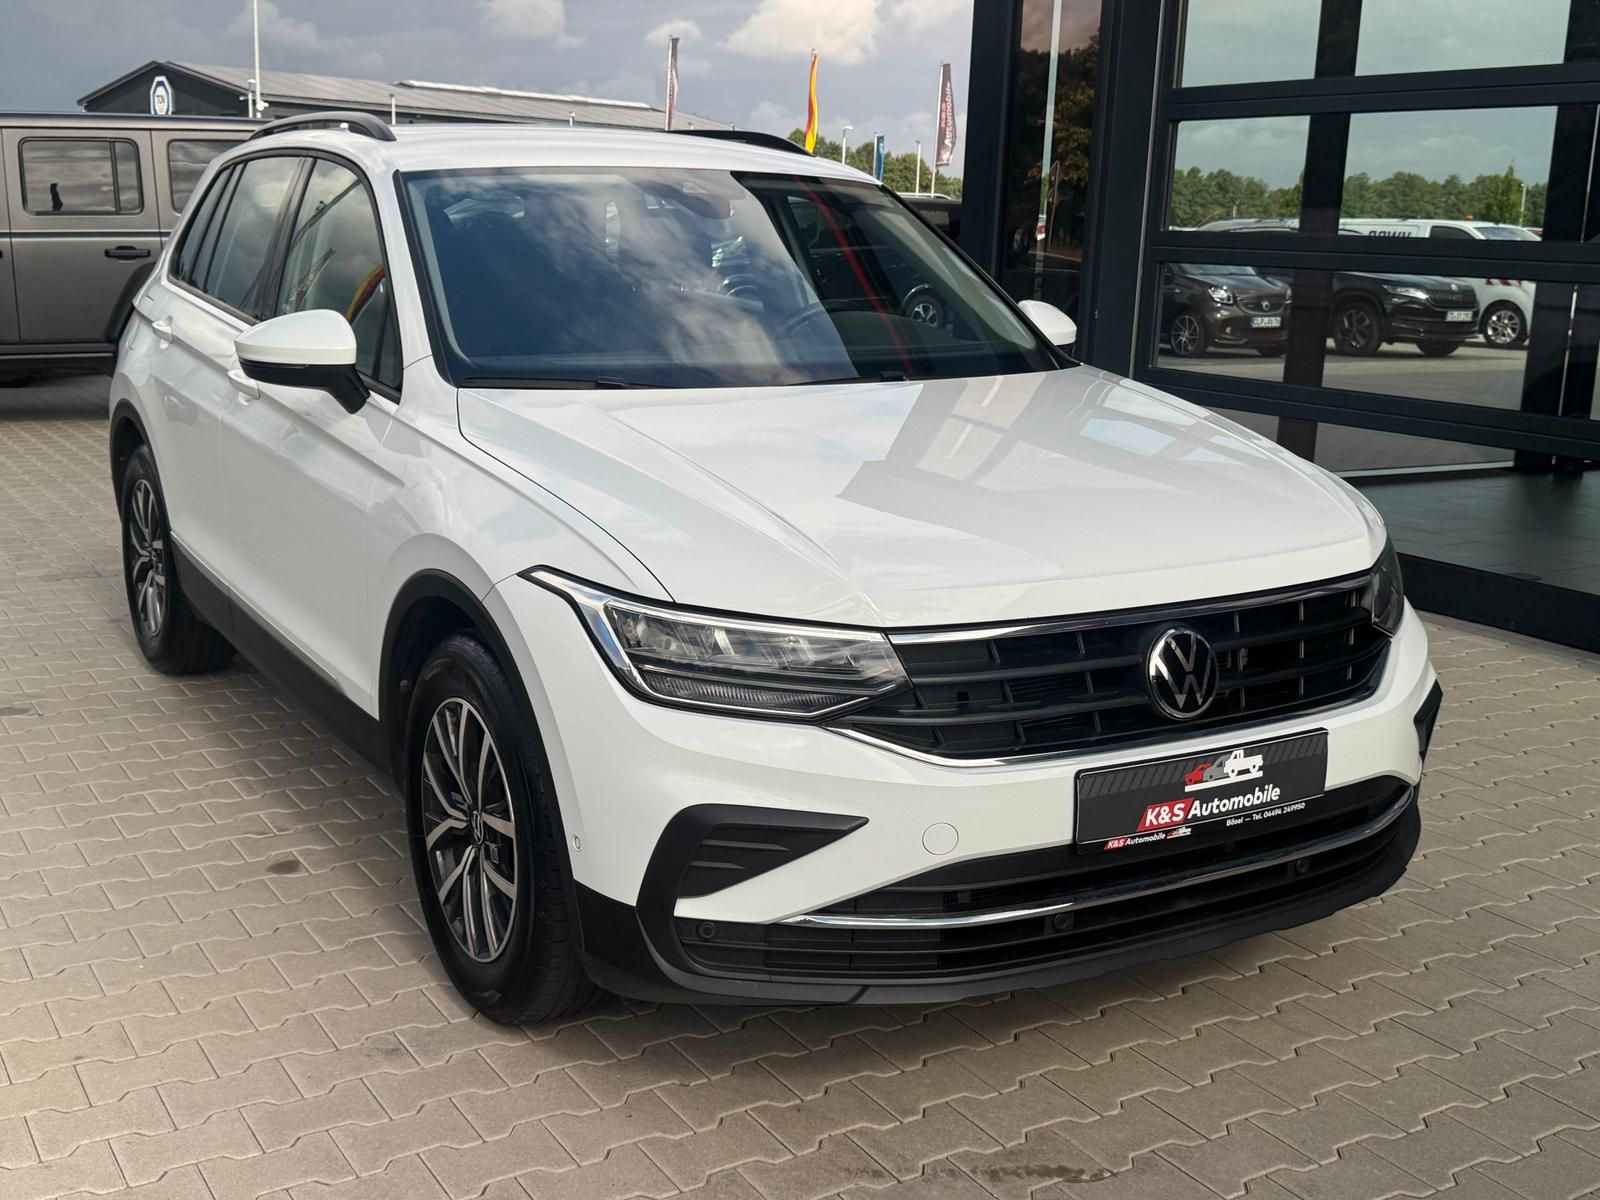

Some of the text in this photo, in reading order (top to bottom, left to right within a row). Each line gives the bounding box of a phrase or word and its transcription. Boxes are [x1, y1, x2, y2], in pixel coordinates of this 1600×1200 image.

[1145, 784, 1281, 827] K&S Automobile
[1226, 816, 1244, 826] Bösel
[1252, 813, 1262, 821] Tel.
[1107, 831, 1166, 849] K&S Automobile
